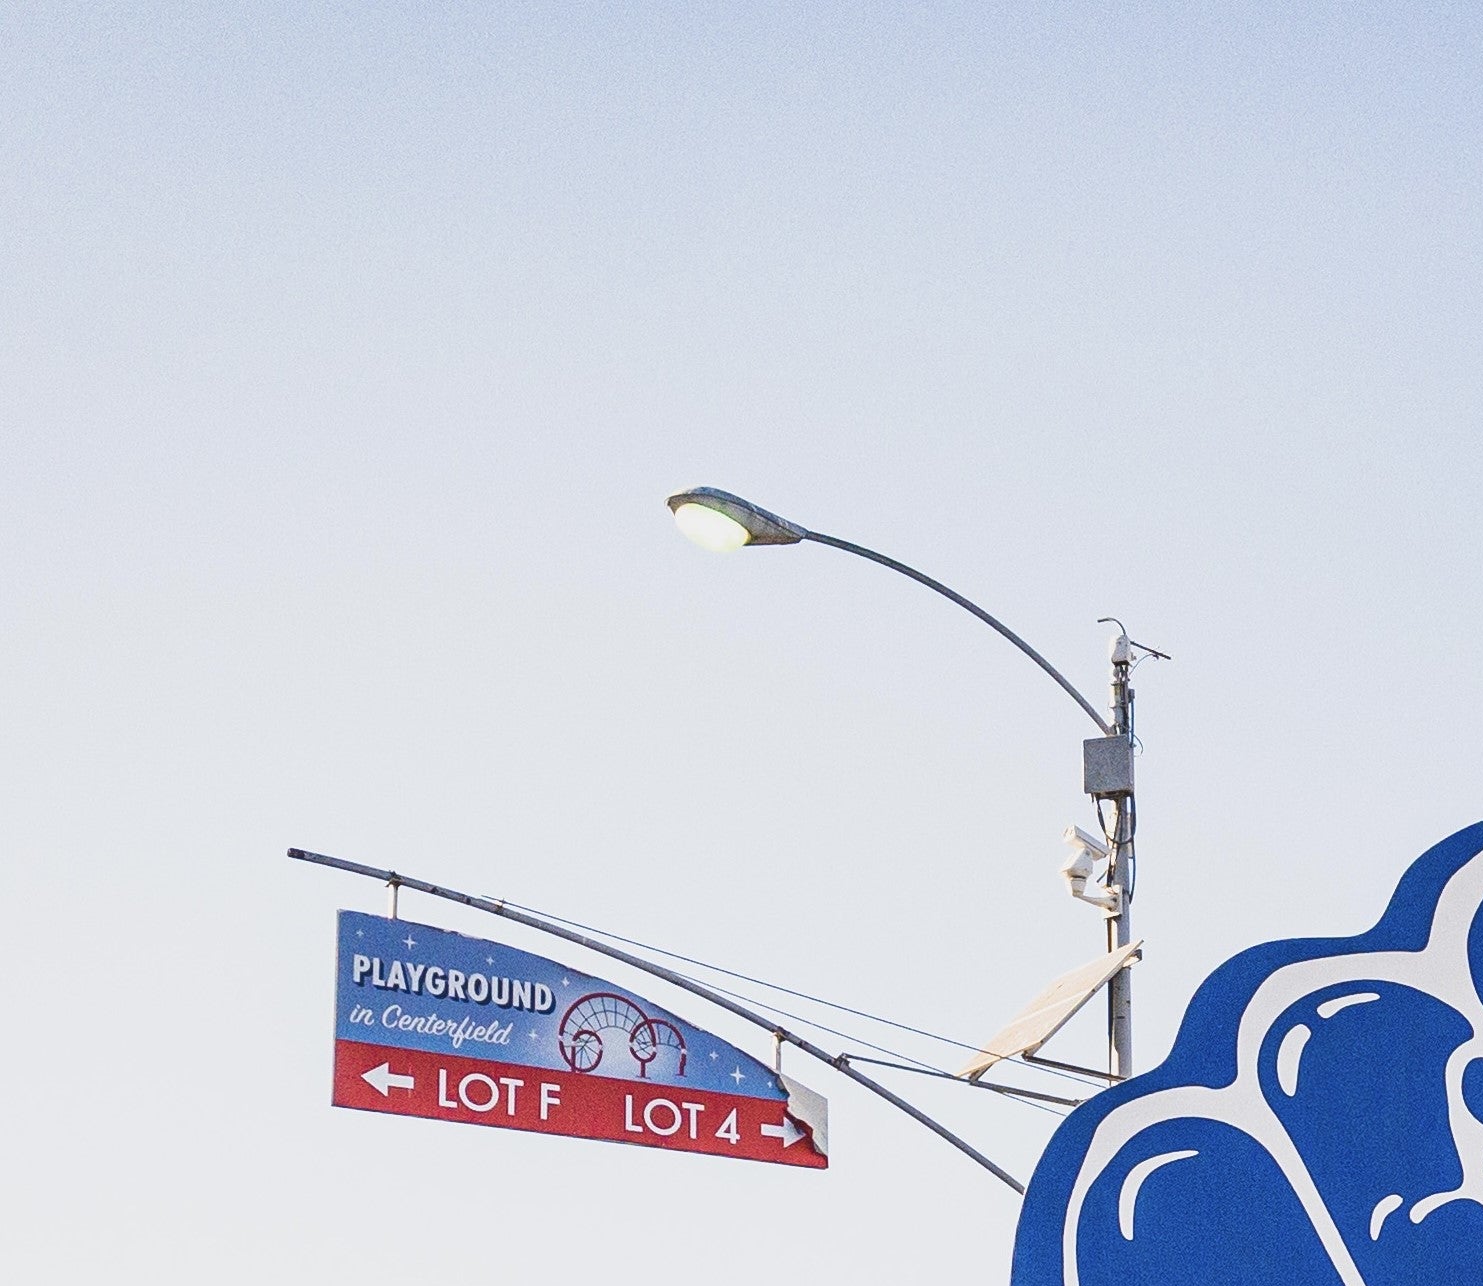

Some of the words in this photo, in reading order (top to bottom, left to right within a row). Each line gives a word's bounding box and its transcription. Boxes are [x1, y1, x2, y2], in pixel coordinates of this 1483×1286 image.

[352, 953, 556, 1013] PLAYGROUND
[349, 1003, 375, 1026] in
[381, 1003, 514, 1047] Centerfield
[438, 1068, 524, 1116] LOT
[540, 1083, 561, 1120] F
[624, 1094, 705, 1139] LOT
[715, 1108, 740, 1145] 4
